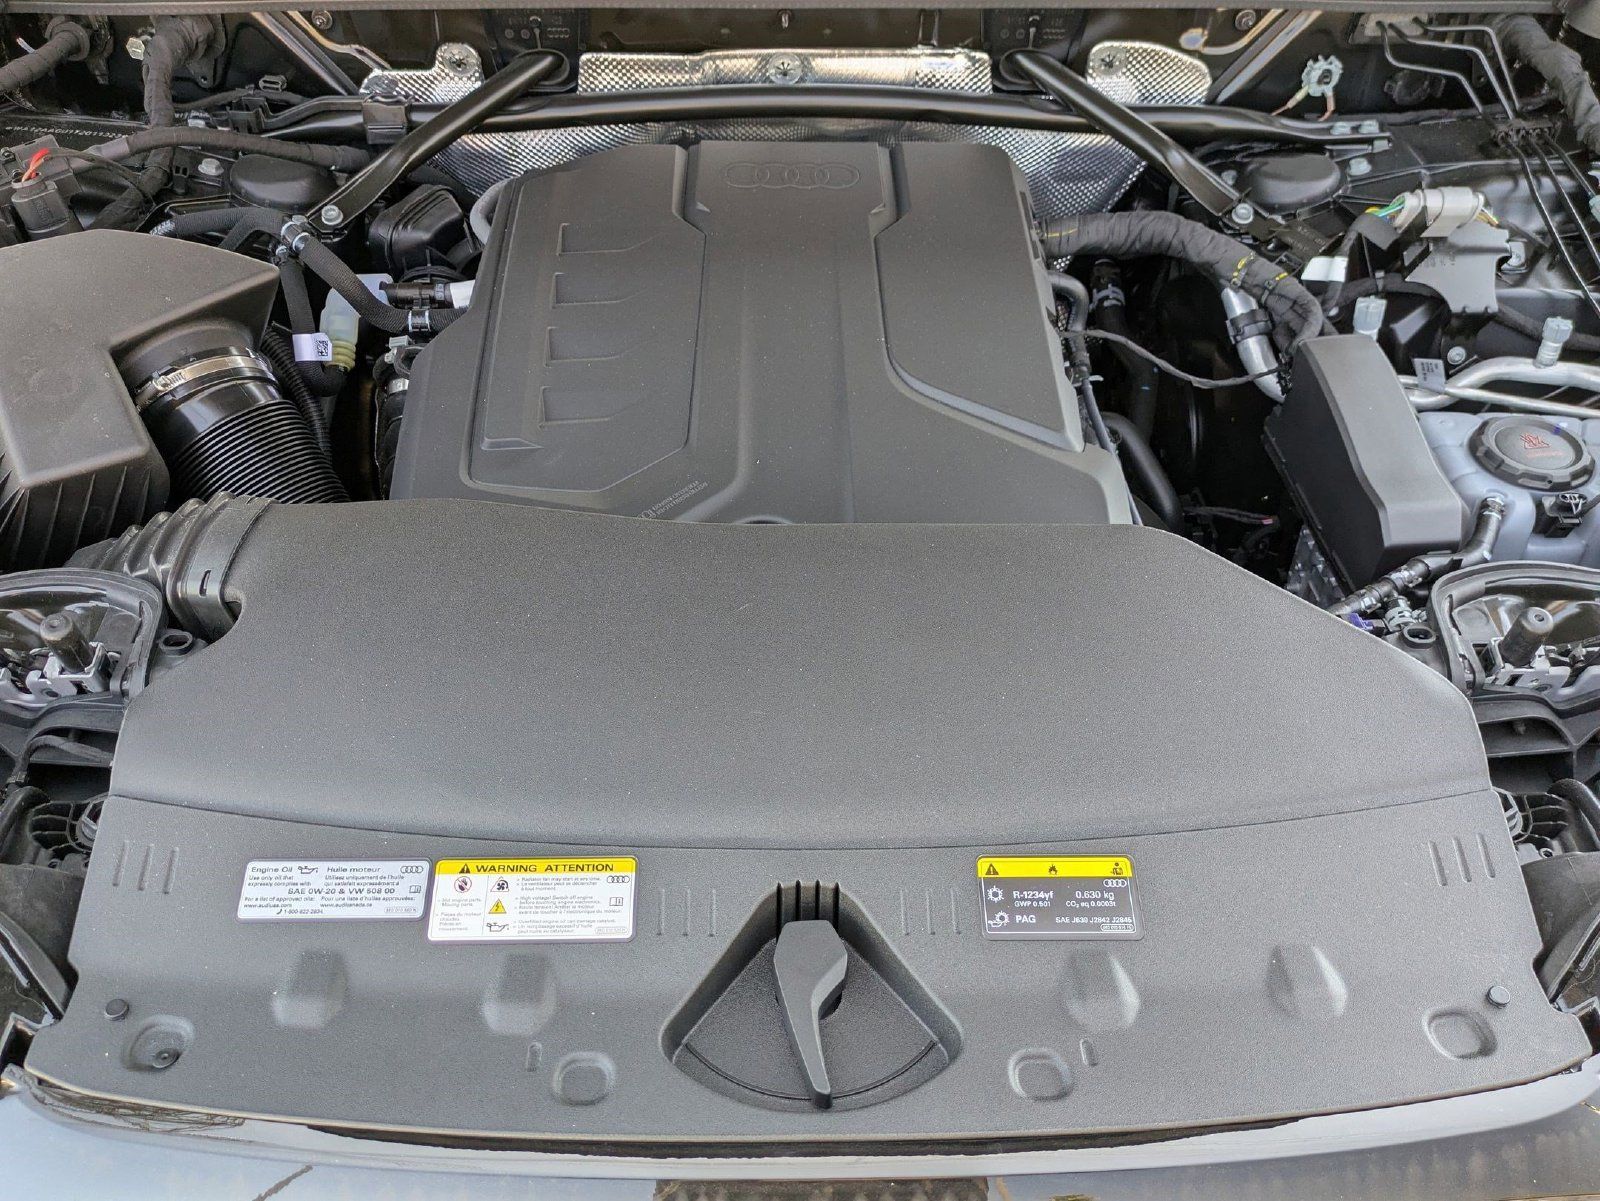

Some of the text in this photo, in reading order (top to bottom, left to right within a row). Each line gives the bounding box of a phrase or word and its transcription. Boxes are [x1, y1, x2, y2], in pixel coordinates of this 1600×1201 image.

[476, 864, 614, 873] WARNING ATTENTION
[1013, 891, 1114, 900] R-1234yf 0.630 kg
[1016, 915, 1036, 923] PAG
